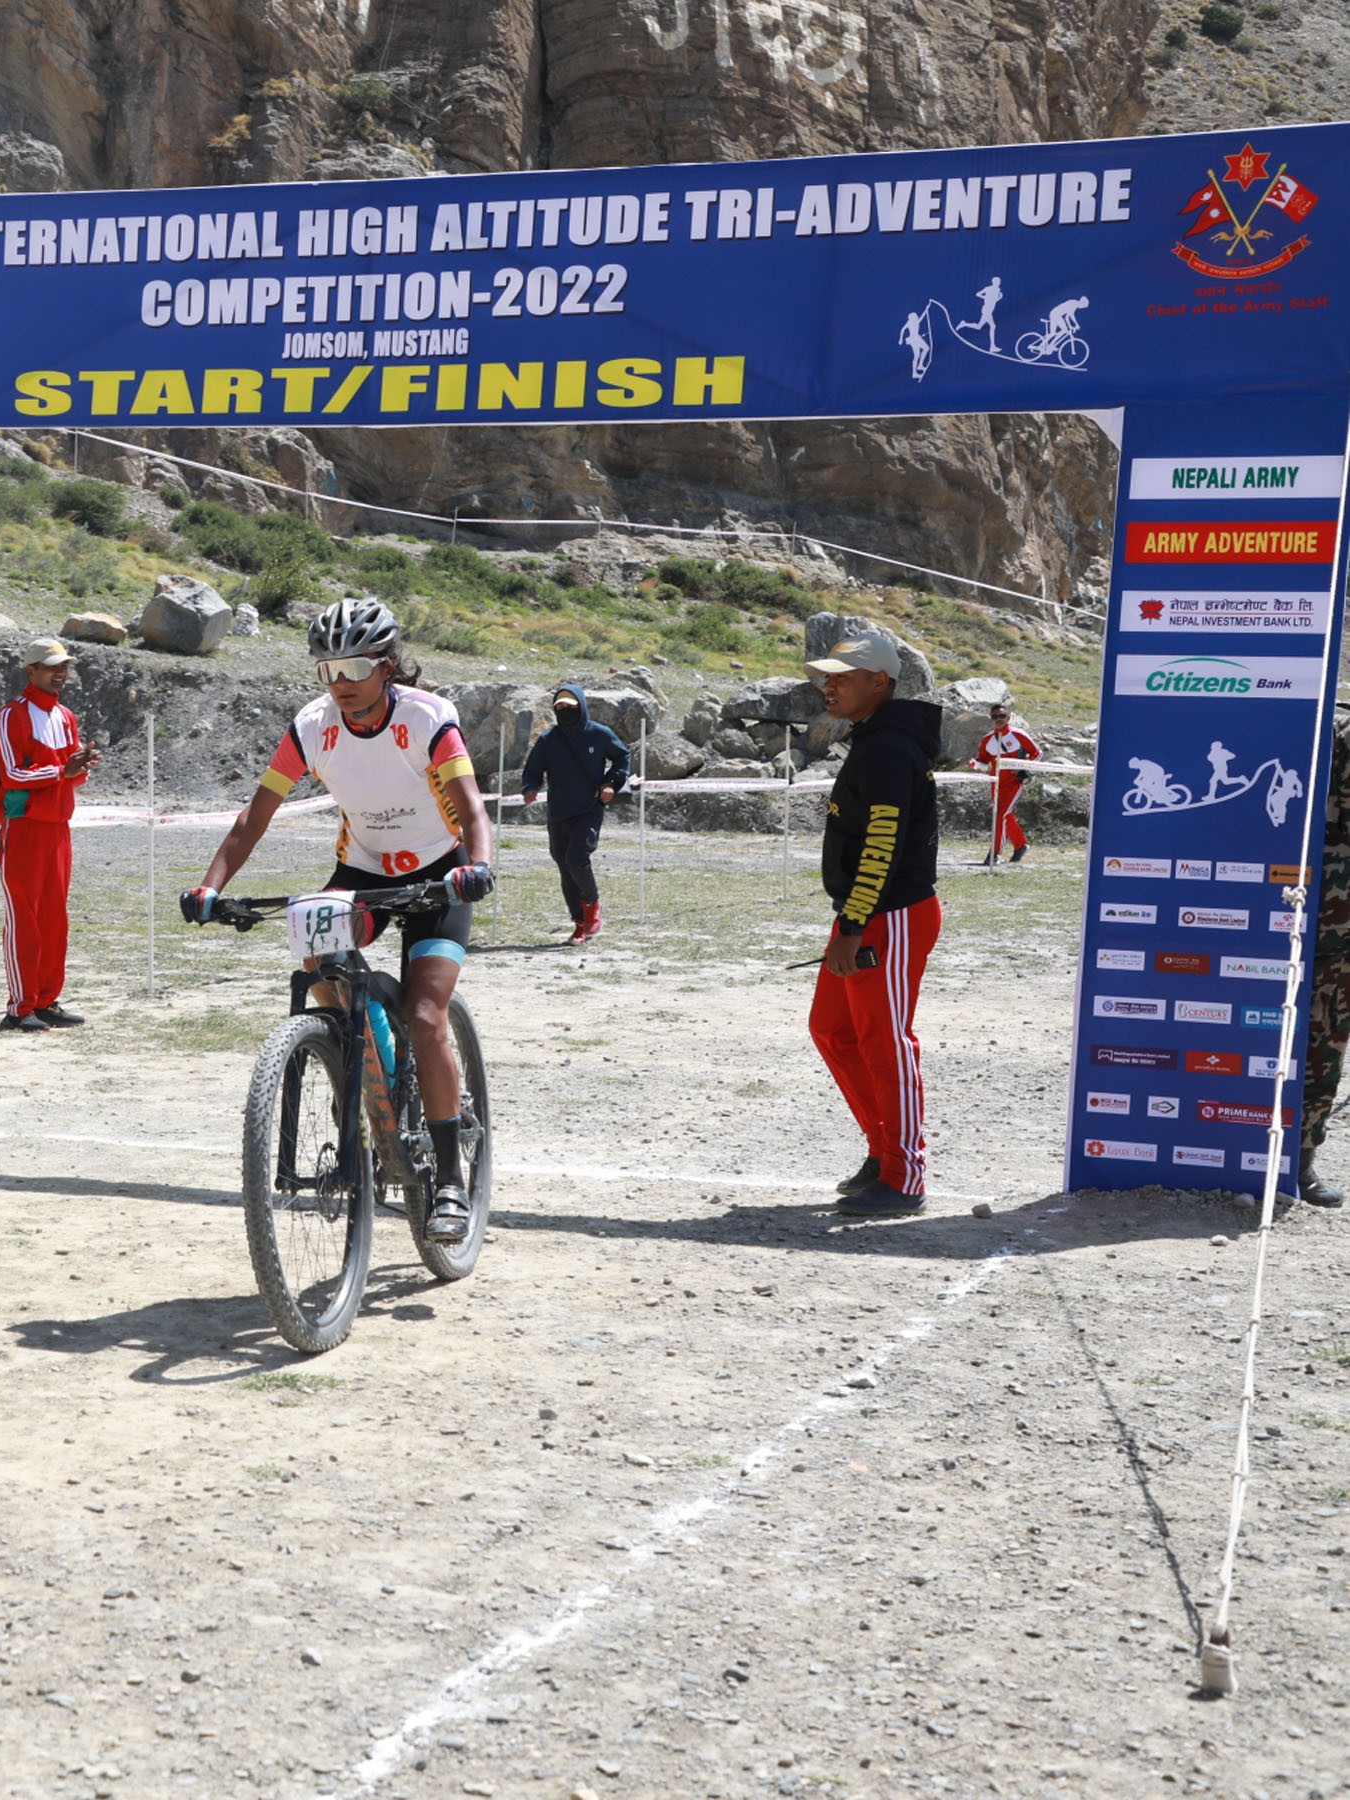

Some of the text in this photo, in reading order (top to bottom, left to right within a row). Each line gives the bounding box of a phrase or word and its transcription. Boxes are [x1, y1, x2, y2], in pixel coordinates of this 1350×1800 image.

[297, 205, 418, 257] HIGH
[430, 192, 670, 252] ALTITUDE
[685, 168, 1132, 241] TRI-ADVENTURE
[141, 264, 628, 327] COMPETITION-2022
[1147, 296, 1329, 317] Chief of the Army Staff
[282, 328, 469, 360] JOMSOM, MUSTANG
[14, 356, 744, 416] START/FINISH
[1172, 466, 1300, 489] NEPALI ARMY
[1144, 532, 1319, 553] ARMY ADVENTURE
[1170, 599, 1198, 611] नेपाल
[1169, 616, 1314, 627] NEPAL INVESTMENT BANK LTD.
[1146, 670, 1292, 693] Citizens Bank
[390, 724, 408, 750] 18
[841, 804, 900, 925] ADVENTURE
[306, 905, 333, 935] 18
[1227, 964, 1259, 973] NABIL
[1134, 1147, 1154, 1158] Bank
